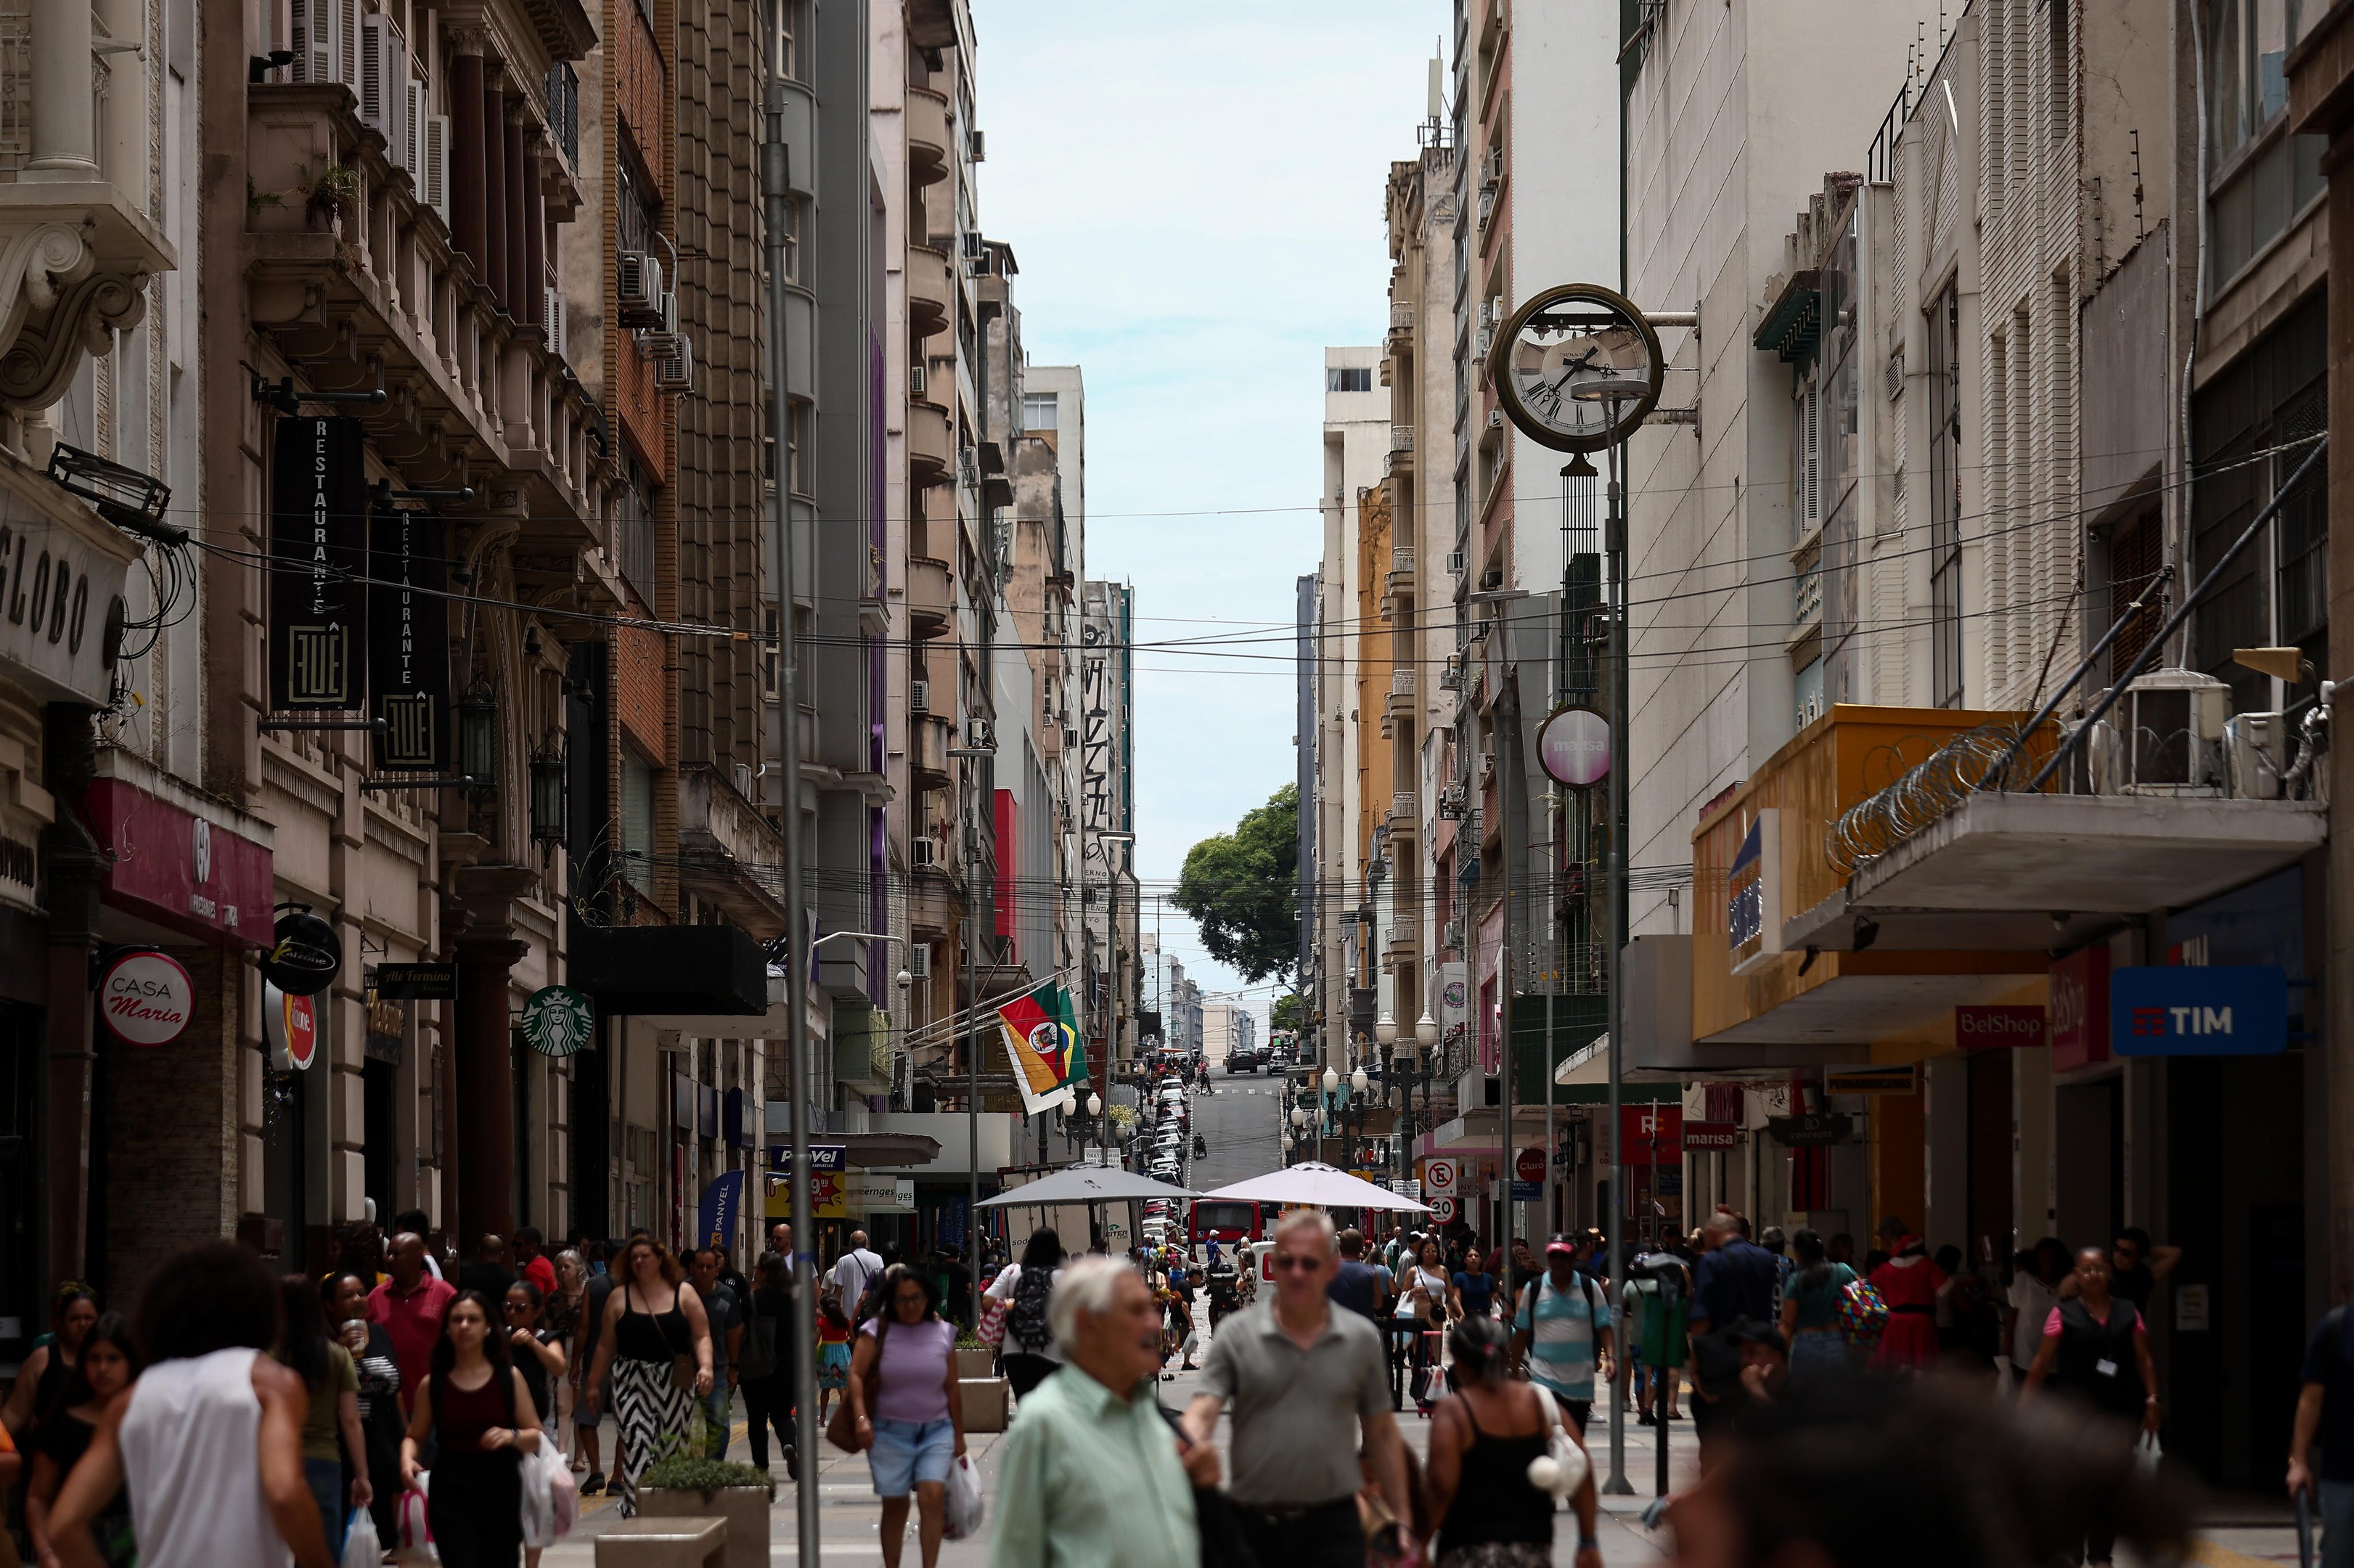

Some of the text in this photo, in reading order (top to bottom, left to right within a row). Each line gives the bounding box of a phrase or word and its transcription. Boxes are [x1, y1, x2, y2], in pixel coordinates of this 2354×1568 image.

[401, 512, 412, 684] RESTAURANTE
[1553, 740, 1605, 752] maisa
[113, 977, 172, 999] CASA
[110, 995, 183, 1024] Maria
[2169, 1006, 2233, 1035] TIM
[1961, 1012, 2041, 1039] BelShop
[1687, 1135, 1733, 1145] marisa
[781, 1151, 838, 1162] PVel
[863, 1188, 895, 1198] ernges
[715, 1184, 730, 1231] PANVEL
[1431, 1201, 1451, 1214] 20
